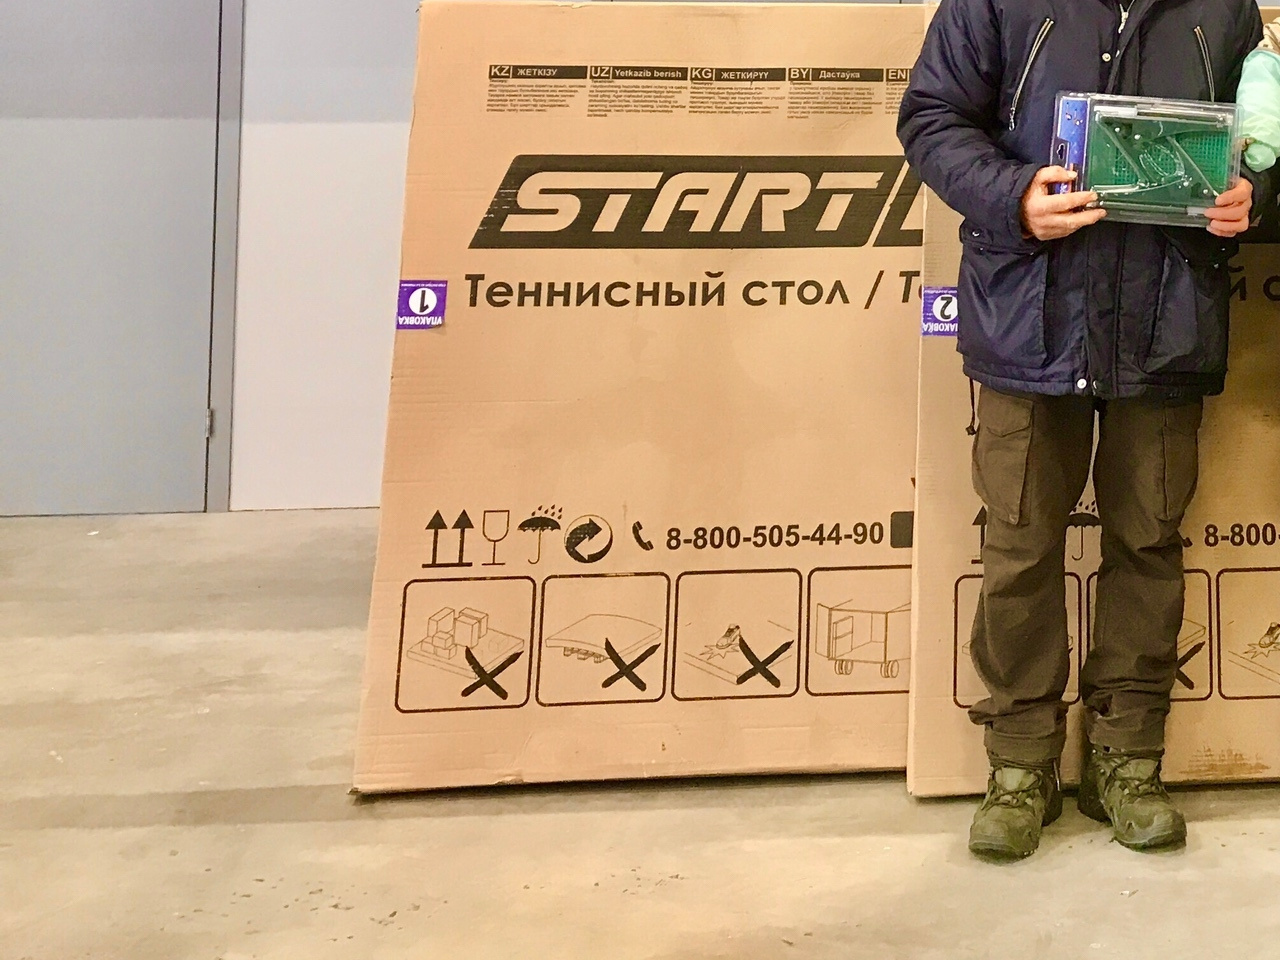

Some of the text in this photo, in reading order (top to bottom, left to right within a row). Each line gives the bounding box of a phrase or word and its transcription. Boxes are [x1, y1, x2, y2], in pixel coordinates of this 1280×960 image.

[491, 66, 510, 77] KZ
[591, 67, 682, 78] UZ Yetkazib berish
[691, 68, 712, 79] KG
[790, 68, 810, 79] BY
[888, 69, 906, 79] EN
[500, 171, 882, 232] START
[464, 271, 735, 308] Теннисный
[741, 278, 850, 305] стол
[419, 290, 429, 313] 1
[940, 296, 953, 320] 2
[398, 316, 443, 325] УПАКОВКА
[922, 322, 958, 332] АКОВКА
[666, 520, 885, 551] 8-800-505-44-90
